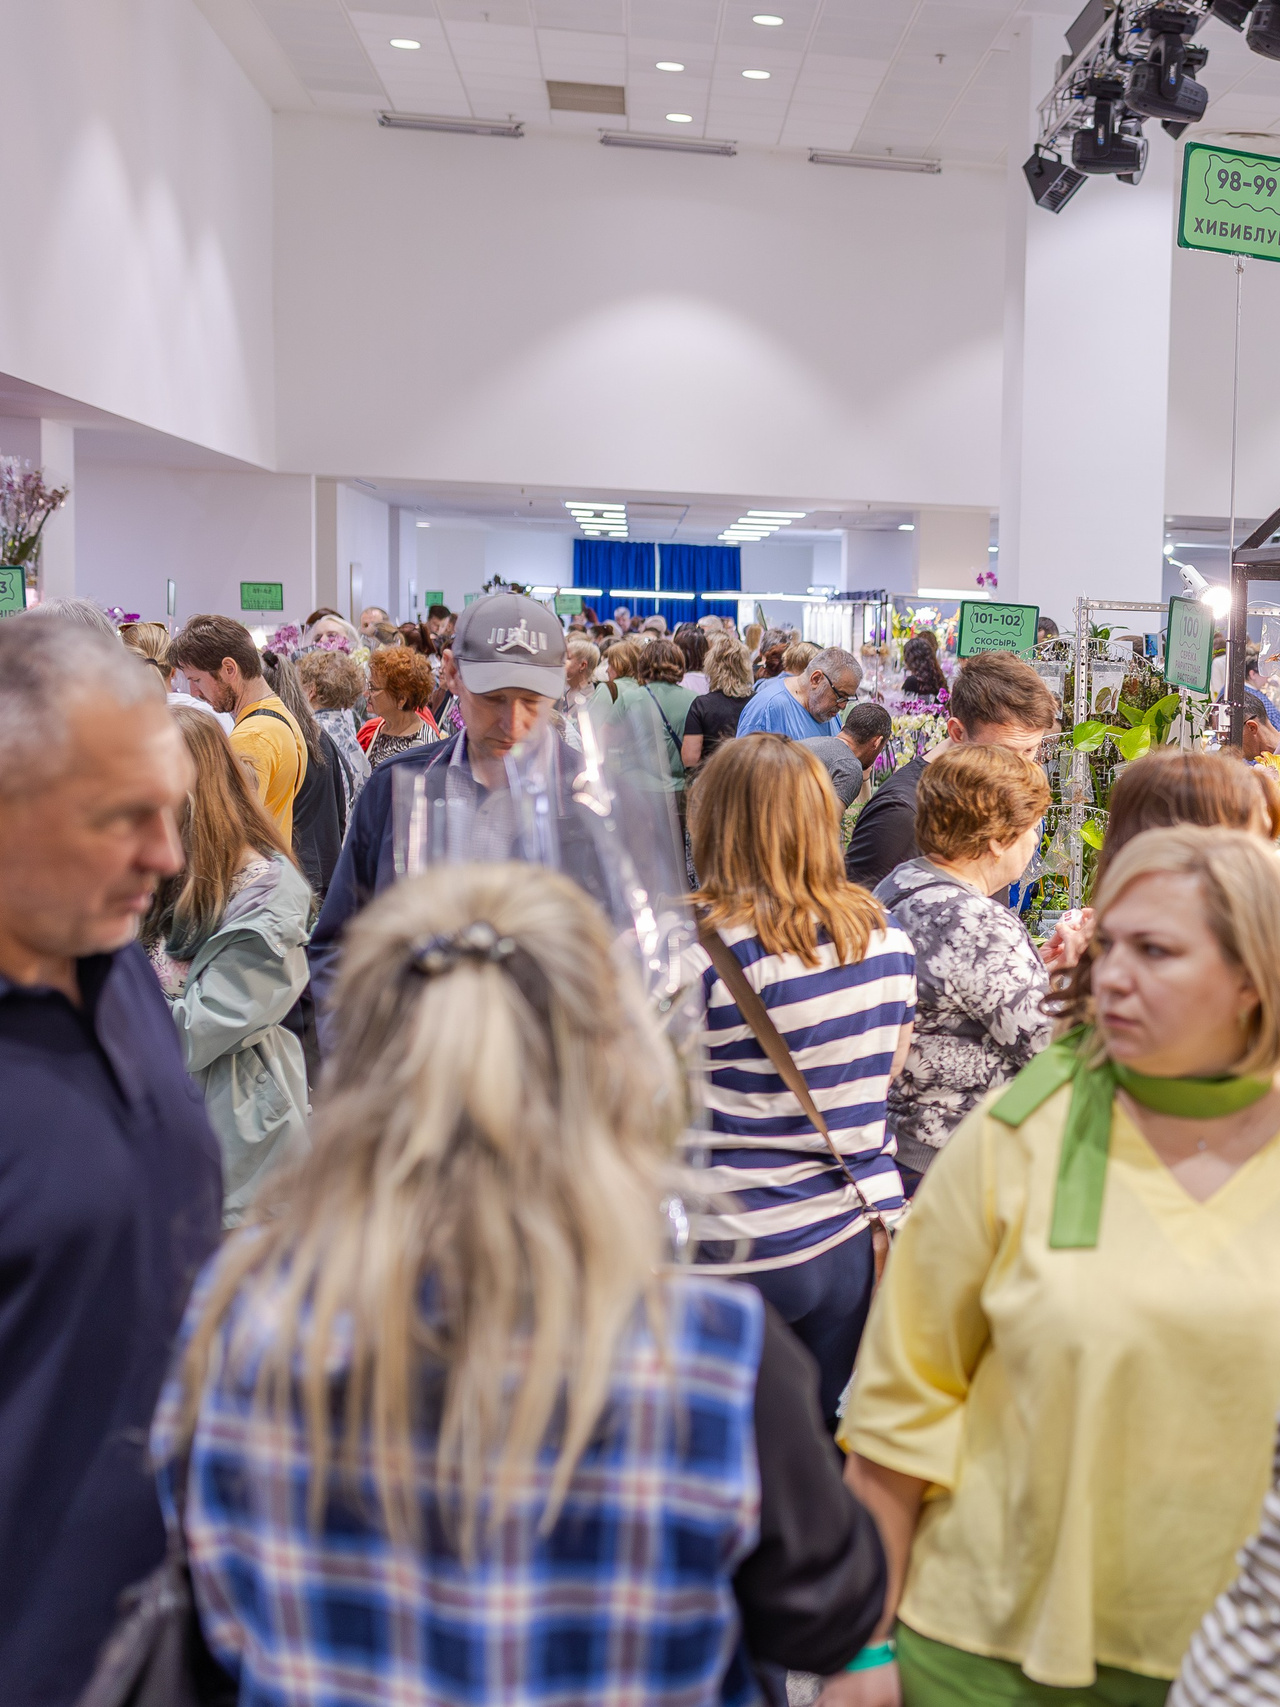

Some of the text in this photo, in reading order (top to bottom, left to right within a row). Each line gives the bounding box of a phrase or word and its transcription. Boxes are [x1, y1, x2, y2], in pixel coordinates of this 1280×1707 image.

[1217, 168, 1278, 198] 98-99
[974, 612, 1021, 627] 101-102
[1183, 616, 1199, 639] 100
[974, 637, 1017, 648] СКОСЫРЬ
